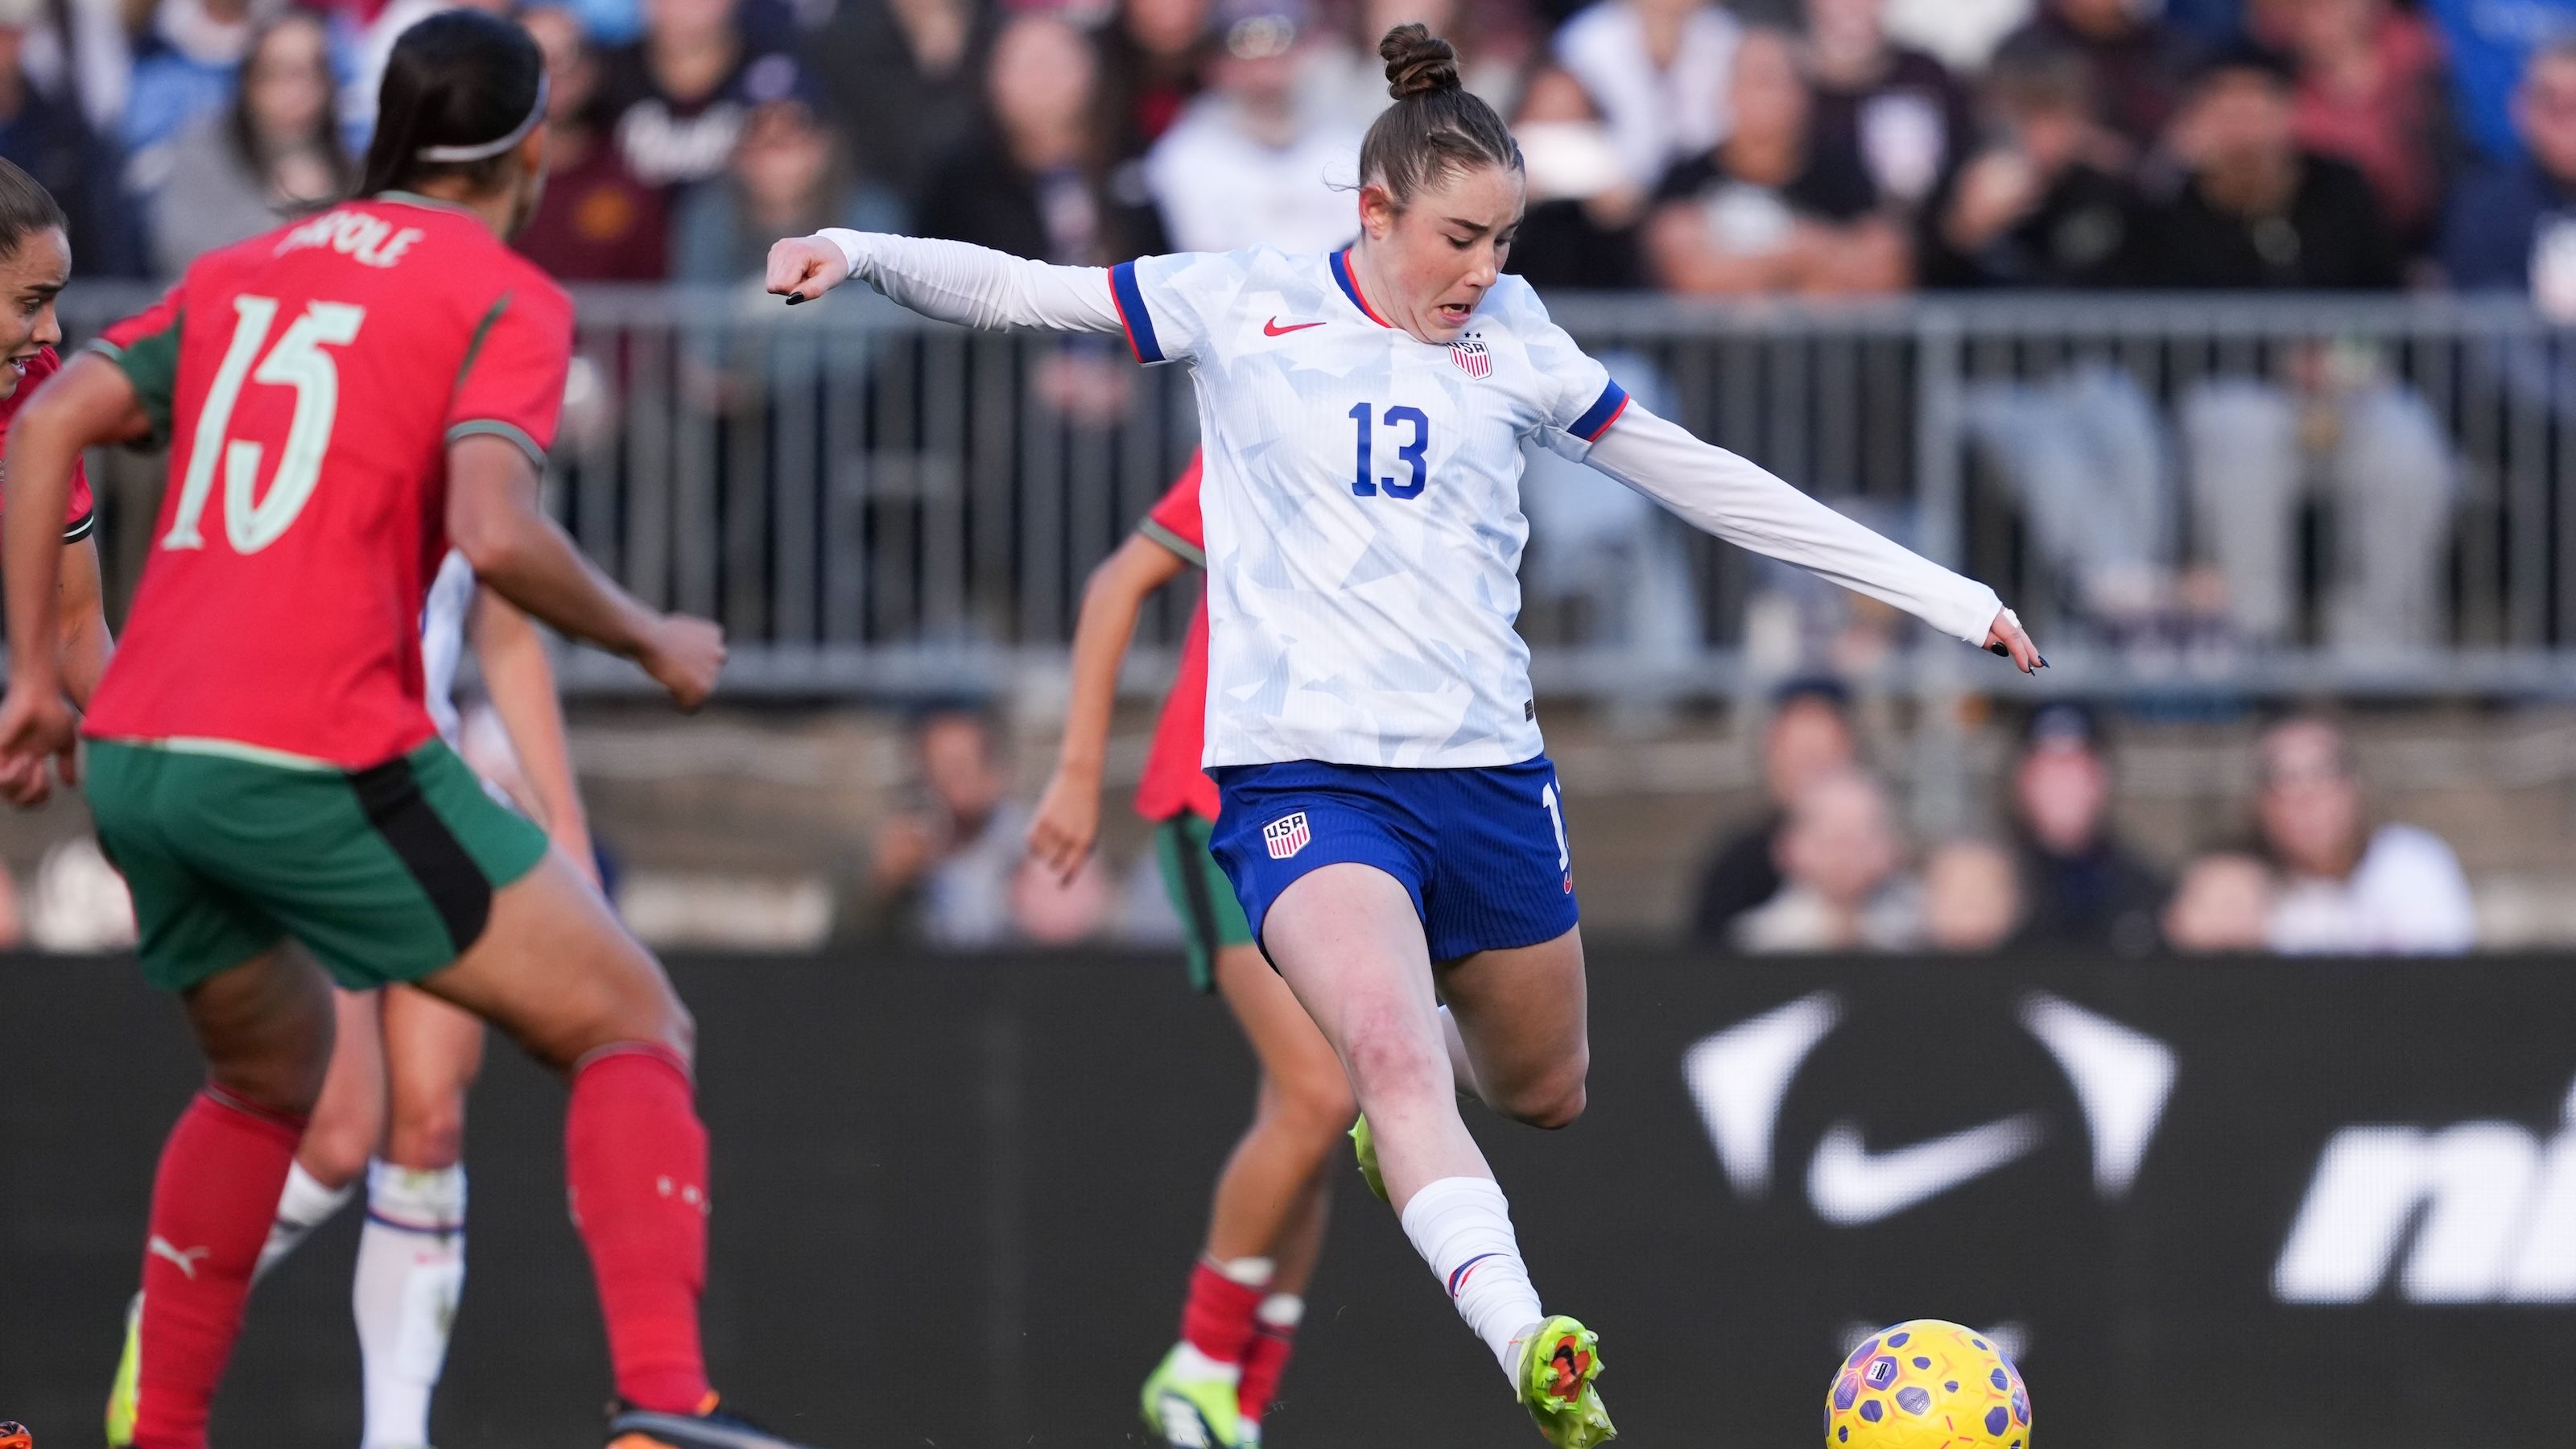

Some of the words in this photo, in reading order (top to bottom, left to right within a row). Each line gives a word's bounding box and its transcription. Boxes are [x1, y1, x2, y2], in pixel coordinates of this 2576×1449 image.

[1445, 341, 1485, 354] USA
[161, 293, 367, 555] 15
[1348, 402, 1429, 500] 13
[1266, 815, 1304, 839] USA
[1542, 774, 1570, 872] 1
